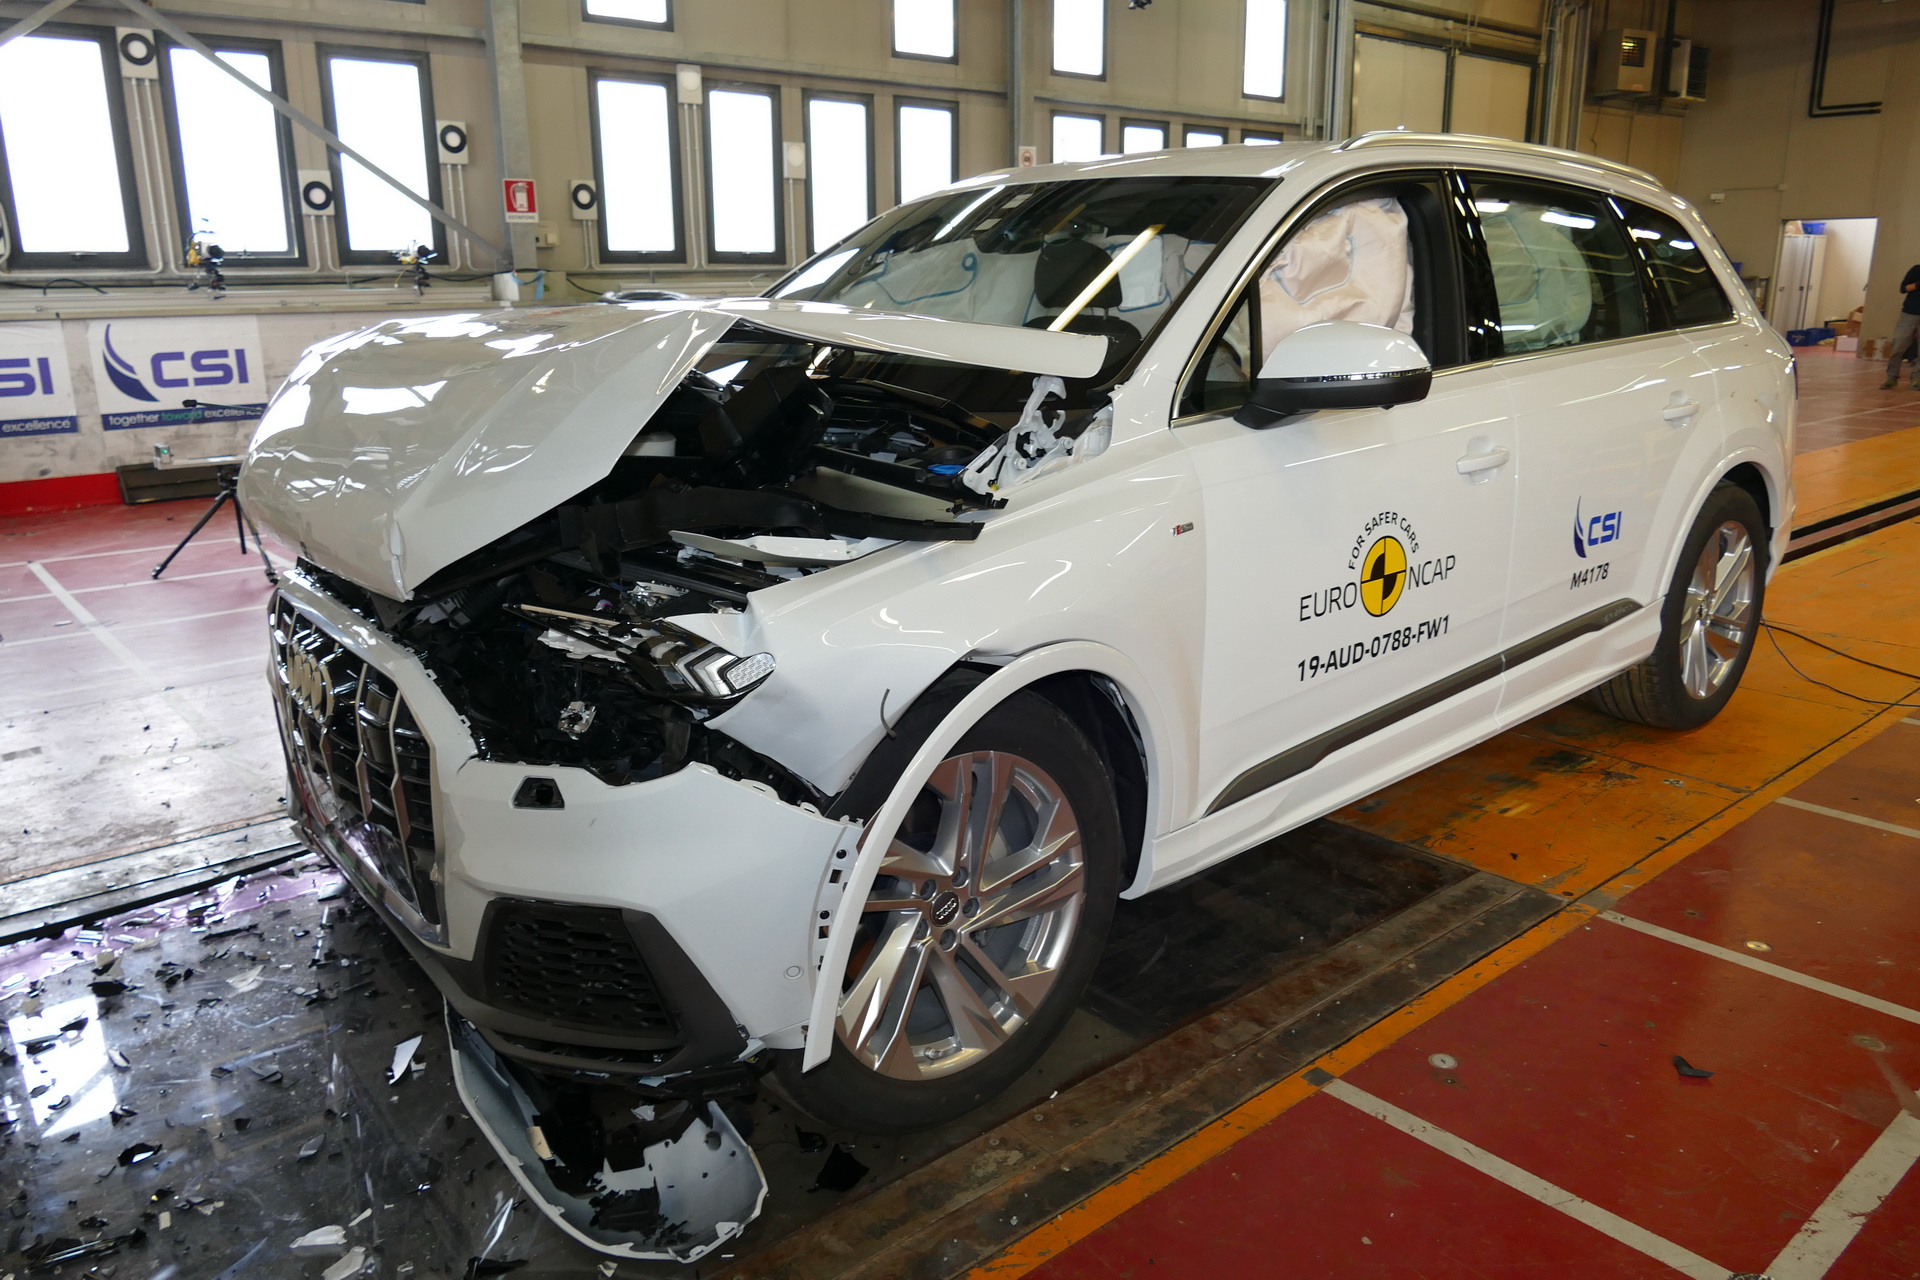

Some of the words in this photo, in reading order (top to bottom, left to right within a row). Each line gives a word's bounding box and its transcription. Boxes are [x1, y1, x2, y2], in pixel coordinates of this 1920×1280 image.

[151, 348, 249, 388] CSI
[2, 419, 71, 433] excellence
[109, 411, 160, 427] together
[162, 408, 203, 421] toward
[1348, 535, 1366, 570] FOR
[1364, 511, 1399, 536] SAFER
[1399, 517, 1420, 554] CARS
[1588, 511, 1622, 546] CSI
[1299, 581, 1358, 622] EURO
[1407, 554, 1456, 590] NCAP
[1569, 562, 1610, 590] M4178
[1297, 614, 1450, 682] 19-AUD-0788-FW1
